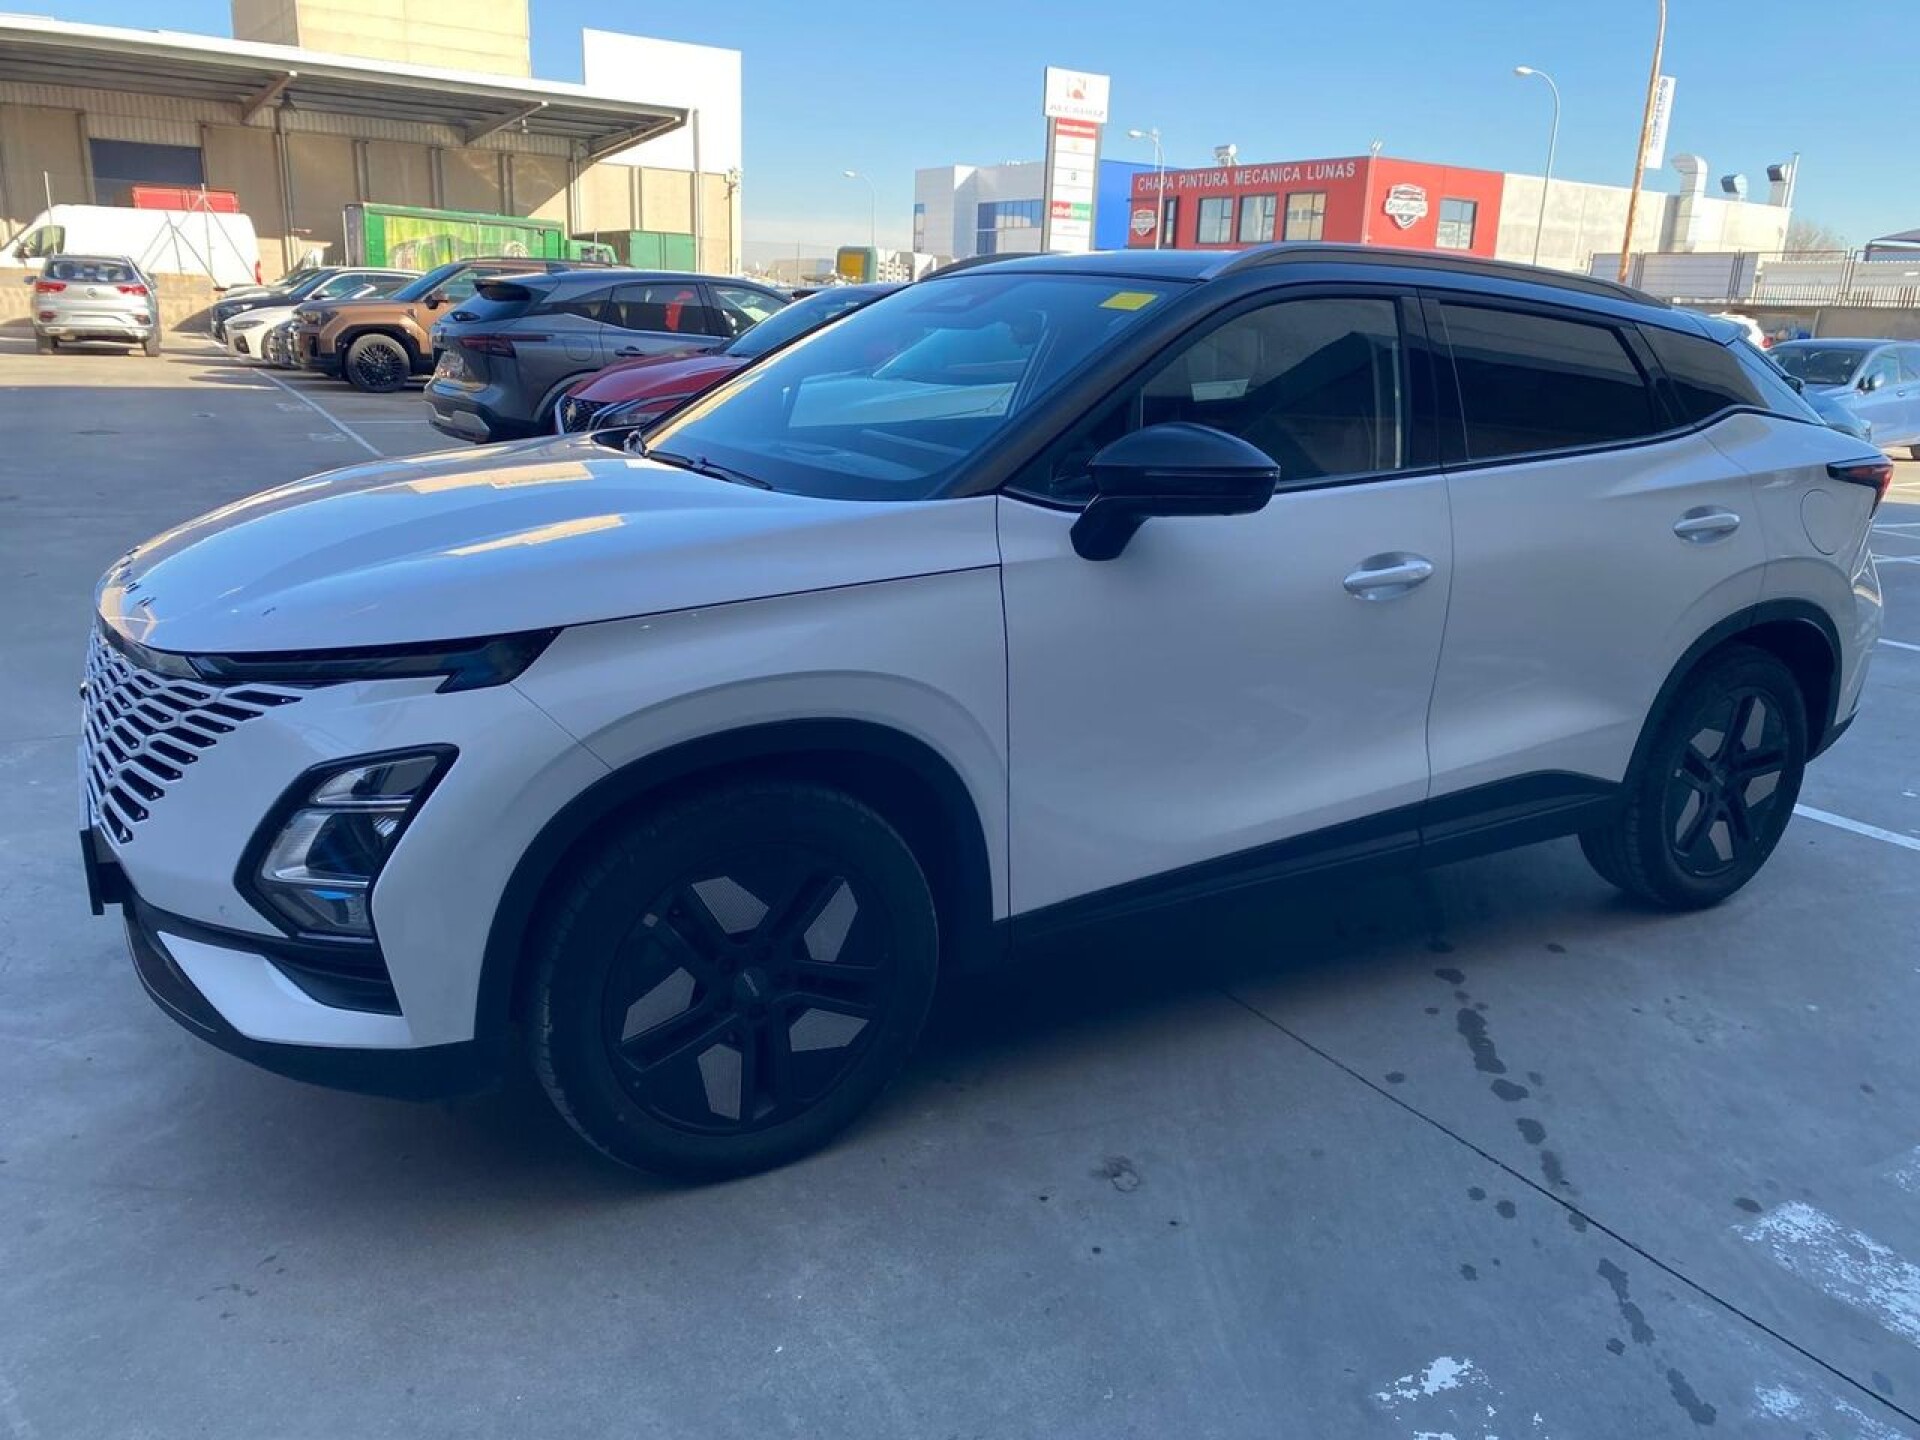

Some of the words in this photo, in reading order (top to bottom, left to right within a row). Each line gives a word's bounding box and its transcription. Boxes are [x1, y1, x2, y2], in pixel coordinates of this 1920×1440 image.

[1138, 173, 1175, 191] CHAPA
[1179, 168, 1229, 188] PINTURA
[1235, 165, 1301, 184] MECANICA
[1307, 162, 1355, 180] LUNAS
